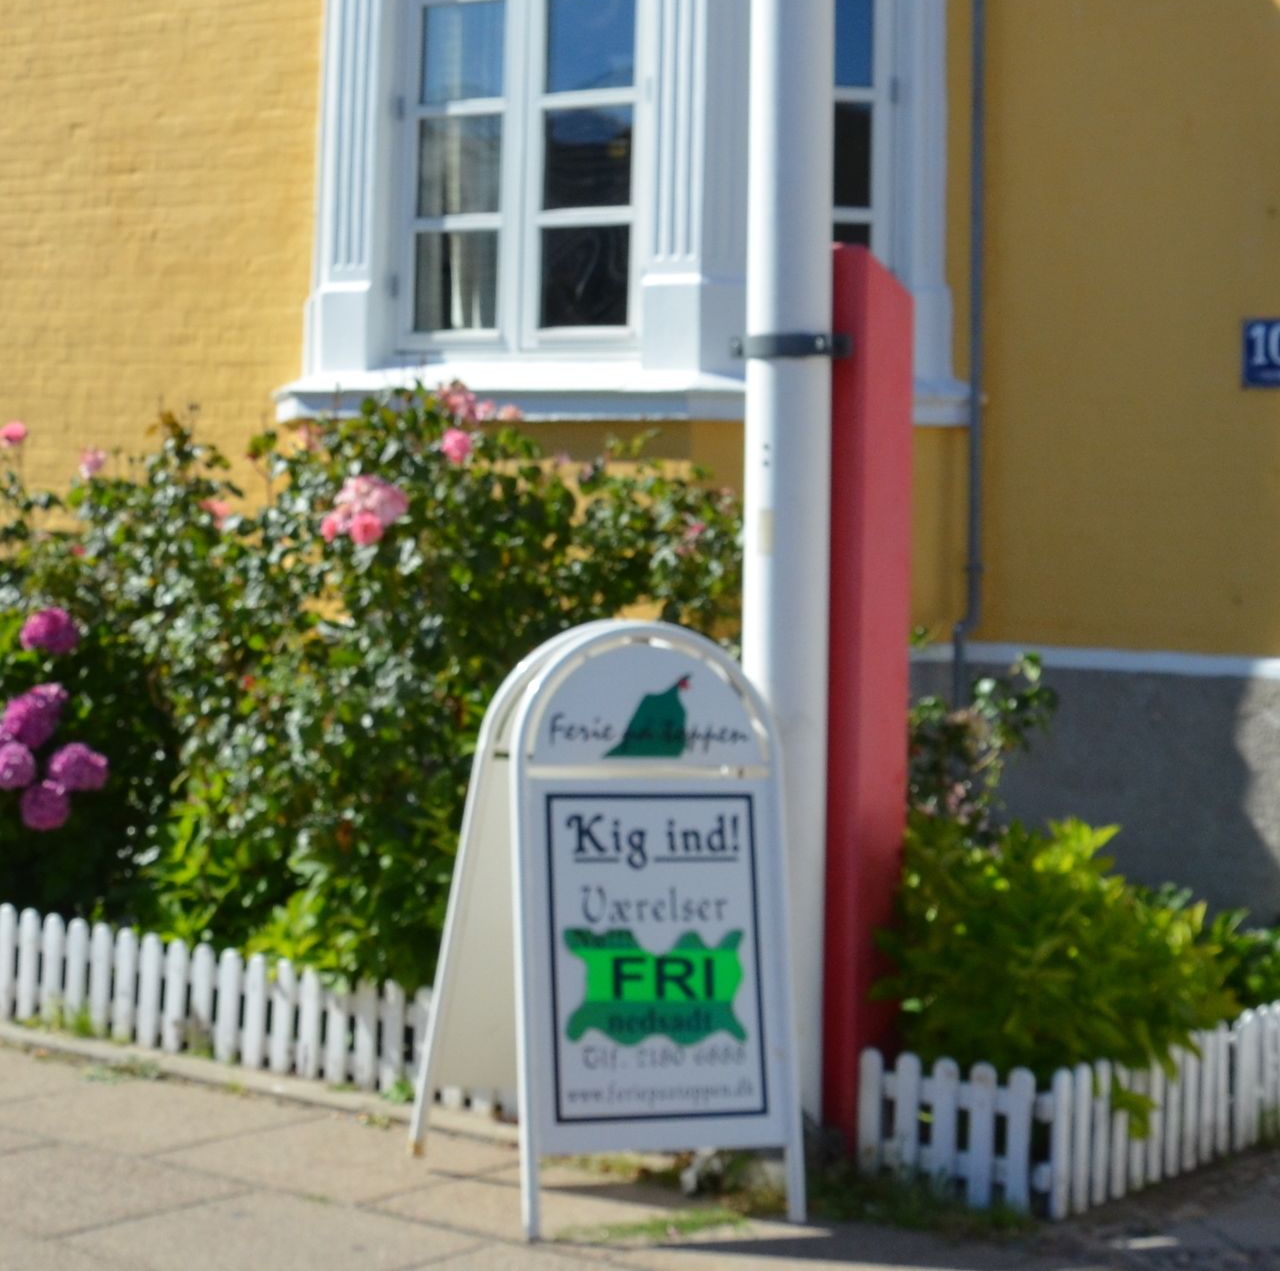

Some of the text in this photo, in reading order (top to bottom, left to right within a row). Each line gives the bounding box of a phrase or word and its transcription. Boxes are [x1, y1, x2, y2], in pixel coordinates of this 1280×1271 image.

[549, 711, 613, 746] Ferie
[566, 812, 739, 870] Kig ind!
[613, 956, 714, 1000] FRI
